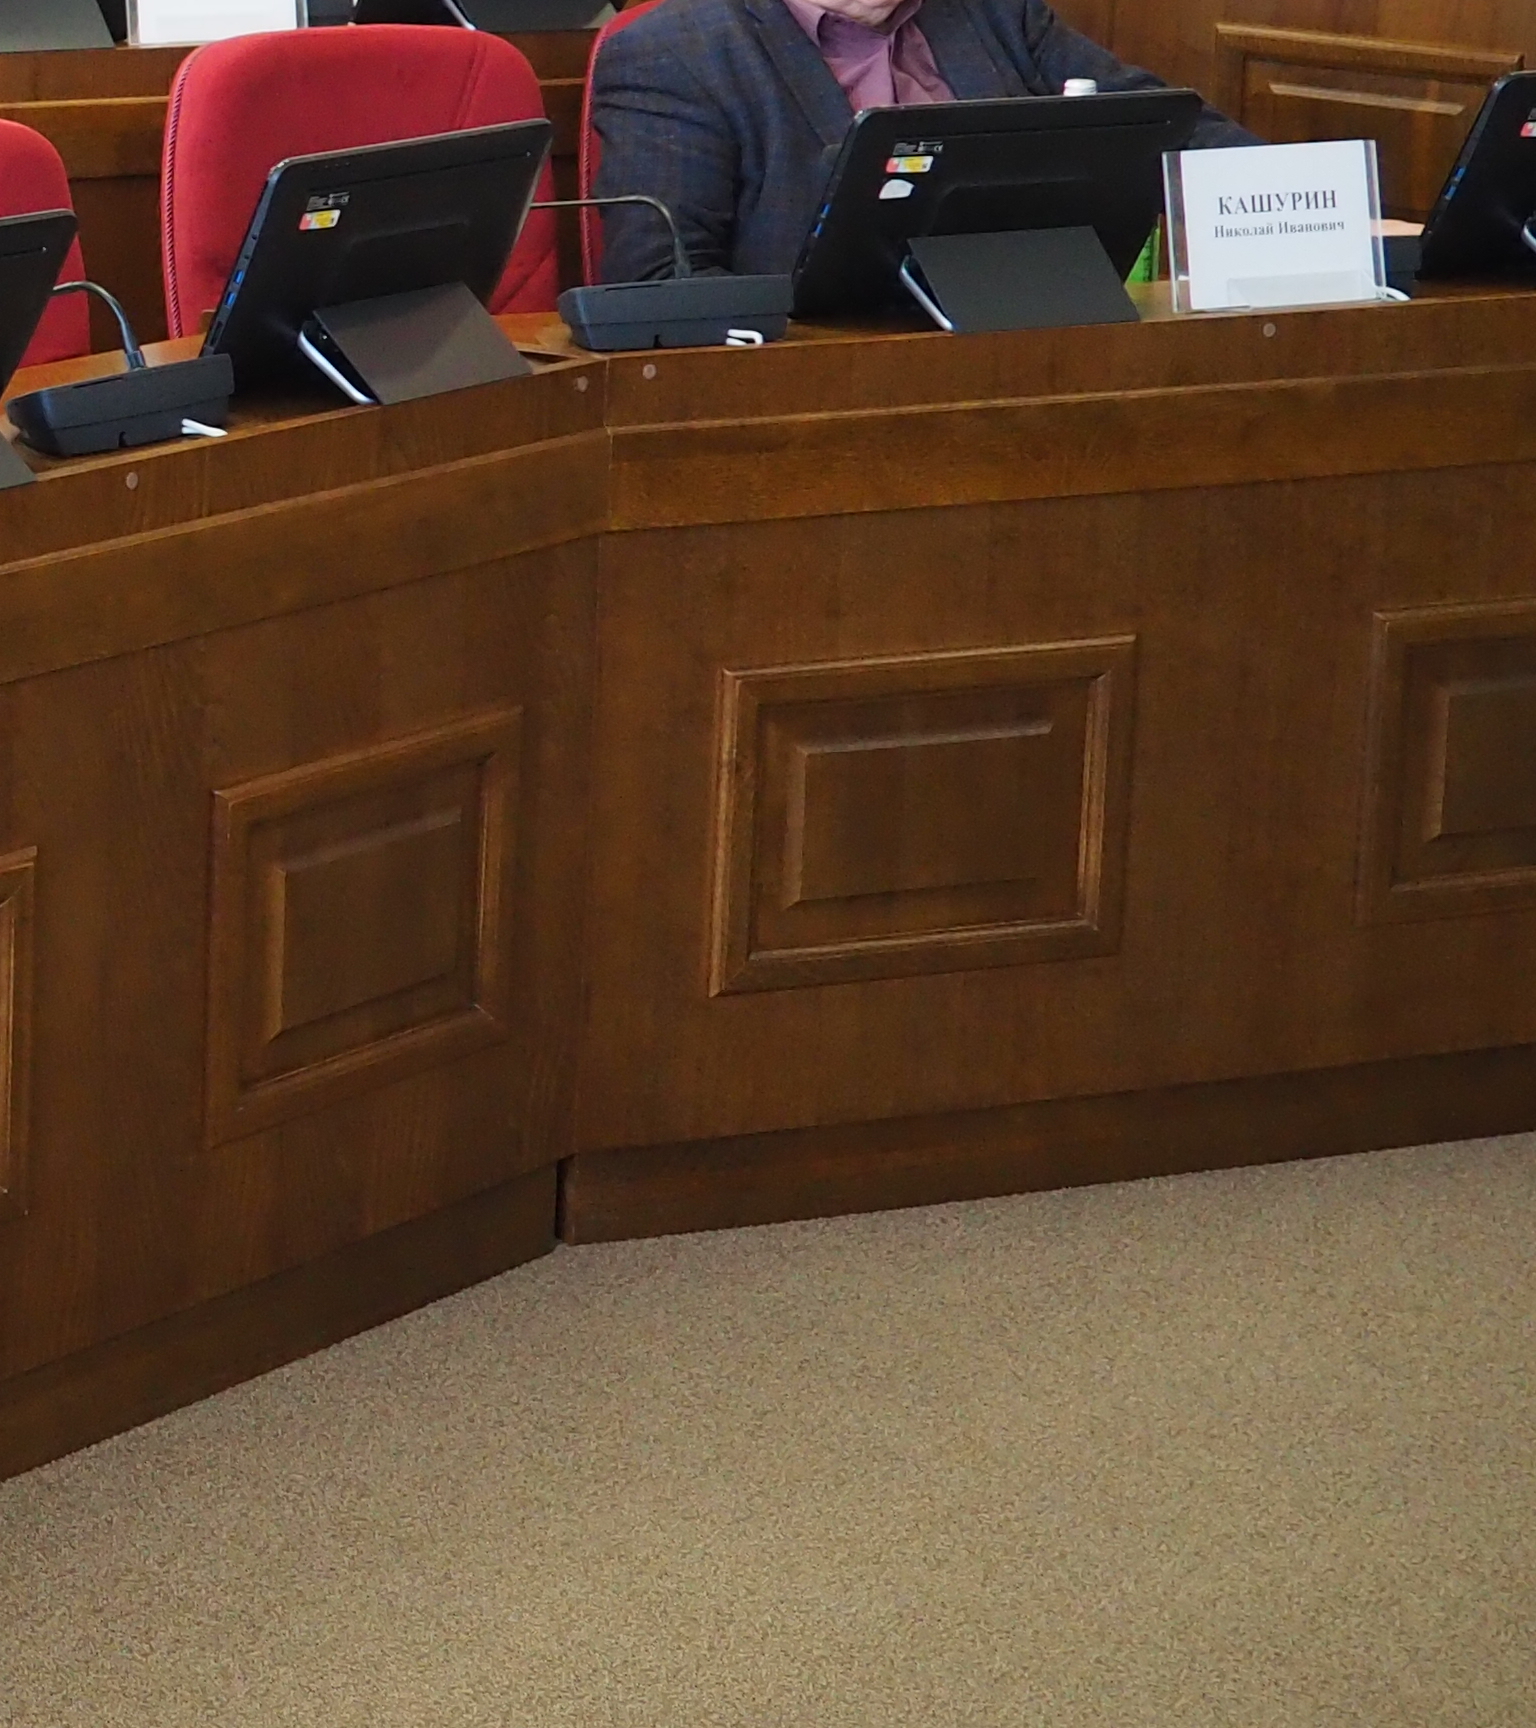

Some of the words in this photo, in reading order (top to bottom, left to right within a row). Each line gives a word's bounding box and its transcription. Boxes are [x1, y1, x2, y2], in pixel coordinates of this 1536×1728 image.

[1218, 190, 1337, 216] КАШУРИН
[1214, 222, 1274, 239] Николай
[1278, 221, 1345, 235] Иванович
